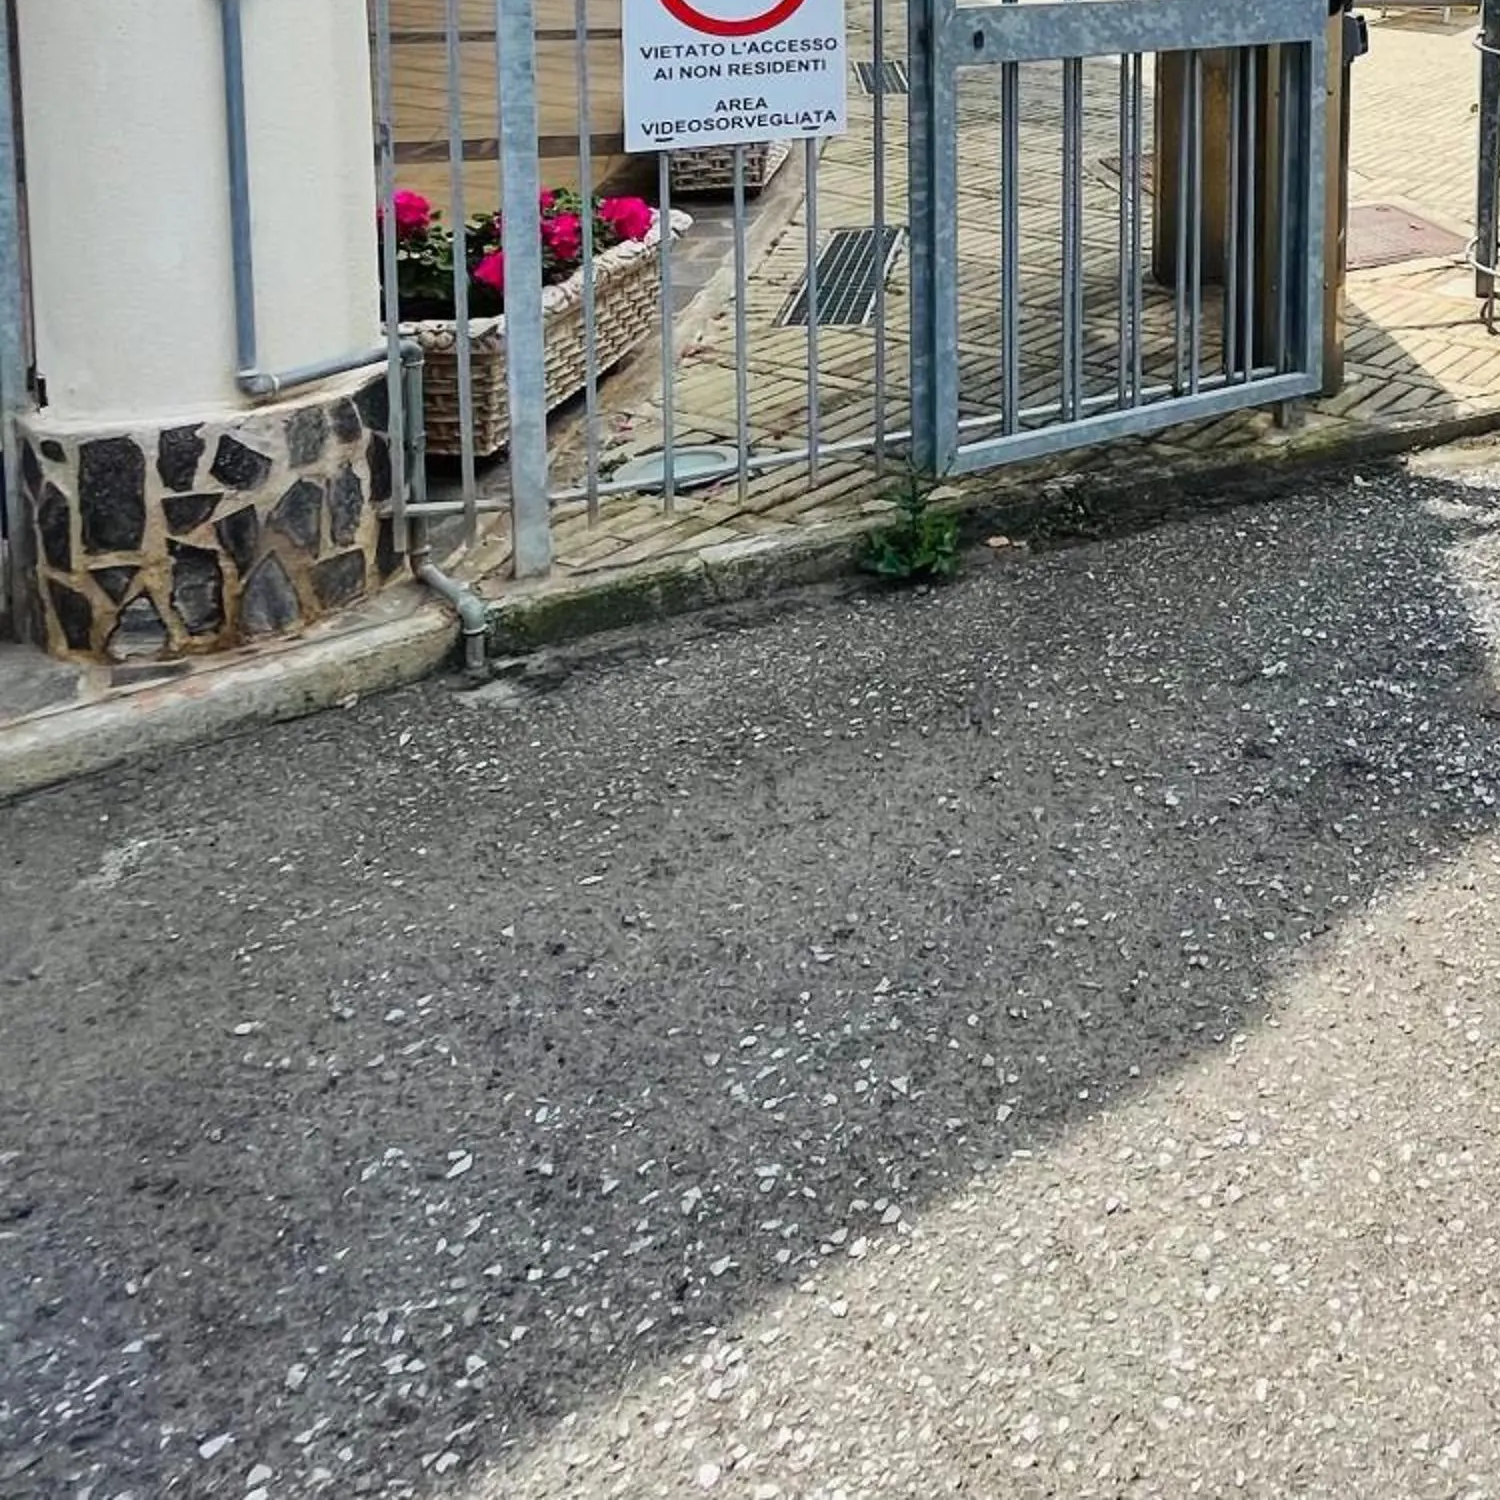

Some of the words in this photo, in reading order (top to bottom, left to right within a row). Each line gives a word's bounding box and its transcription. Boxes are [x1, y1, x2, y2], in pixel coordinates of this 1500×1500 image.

[640, 43, 725, 60] VIETATO
[731, 38, 837, 55] L'ACCESSO
[654, 67, 673, 81] AI
[679, 64, 721, 79] NON
[728, 59, 827, 77] RESIDENTI
[714, 97, 768, 113] AREA
[641, 110, 837, 136] VIDEOSORVEGLIATA
